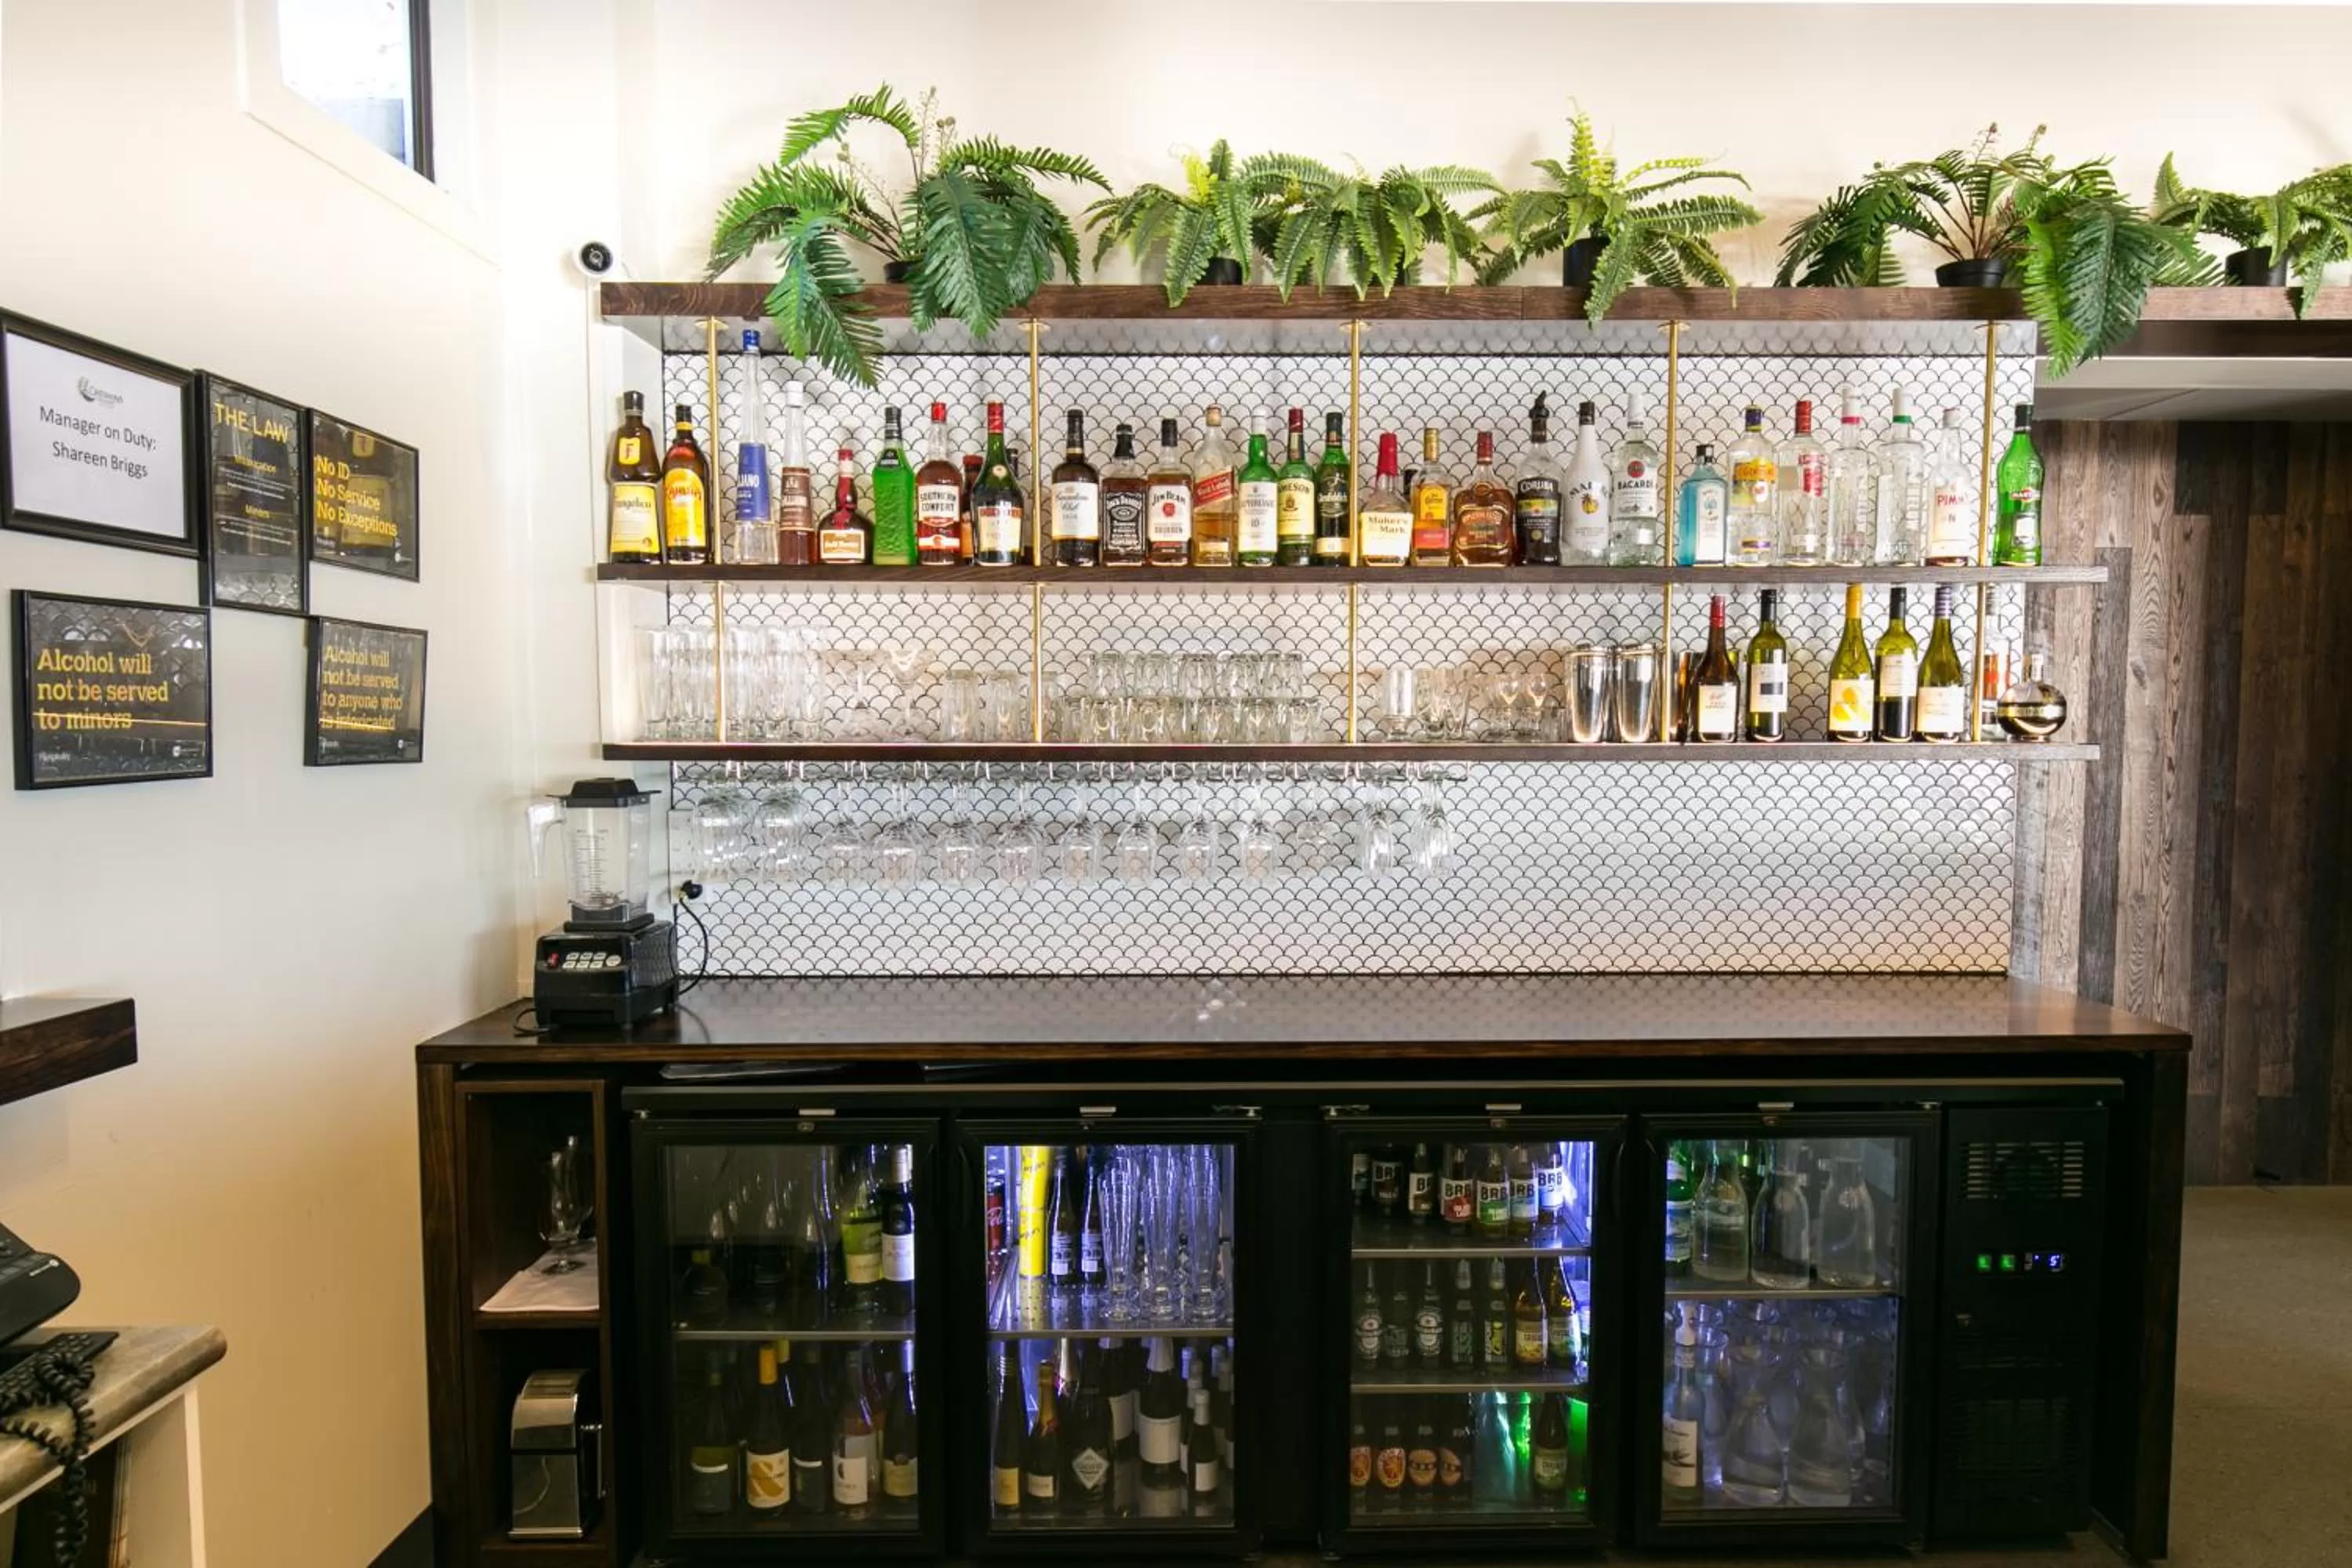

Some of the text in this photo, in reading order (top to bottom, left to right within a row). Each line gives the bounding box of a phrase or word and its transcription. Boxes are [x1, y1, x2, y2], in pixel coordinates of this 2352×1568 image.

[39, 405, 157, 452] Manager on Duty:
[213, 401, 289, 445] THE LAW
[53, 441, 148, 479] Shareen Briggs
[317, 454, 350, 481] No ID
[316, 477, 336, 499] No
[338, 484, 381, 512] Service
[920, 492, 957, 503] SOUTHERN
[1617, 479, 1654, 491] BACARDI
[316, 500, 397, 538] No Exceptions
[921, 502, 954, 512] COMFORT
[37, 648, 152, 675] Alcohol will
[324, 644, 390, 667] Alcohol will
[37, 677, 169, 702] not be served
[323, 668, 399, 689] not be served
[323, 689, 403, 712] to anyone who
[38, 707, 132, 730] to minors
